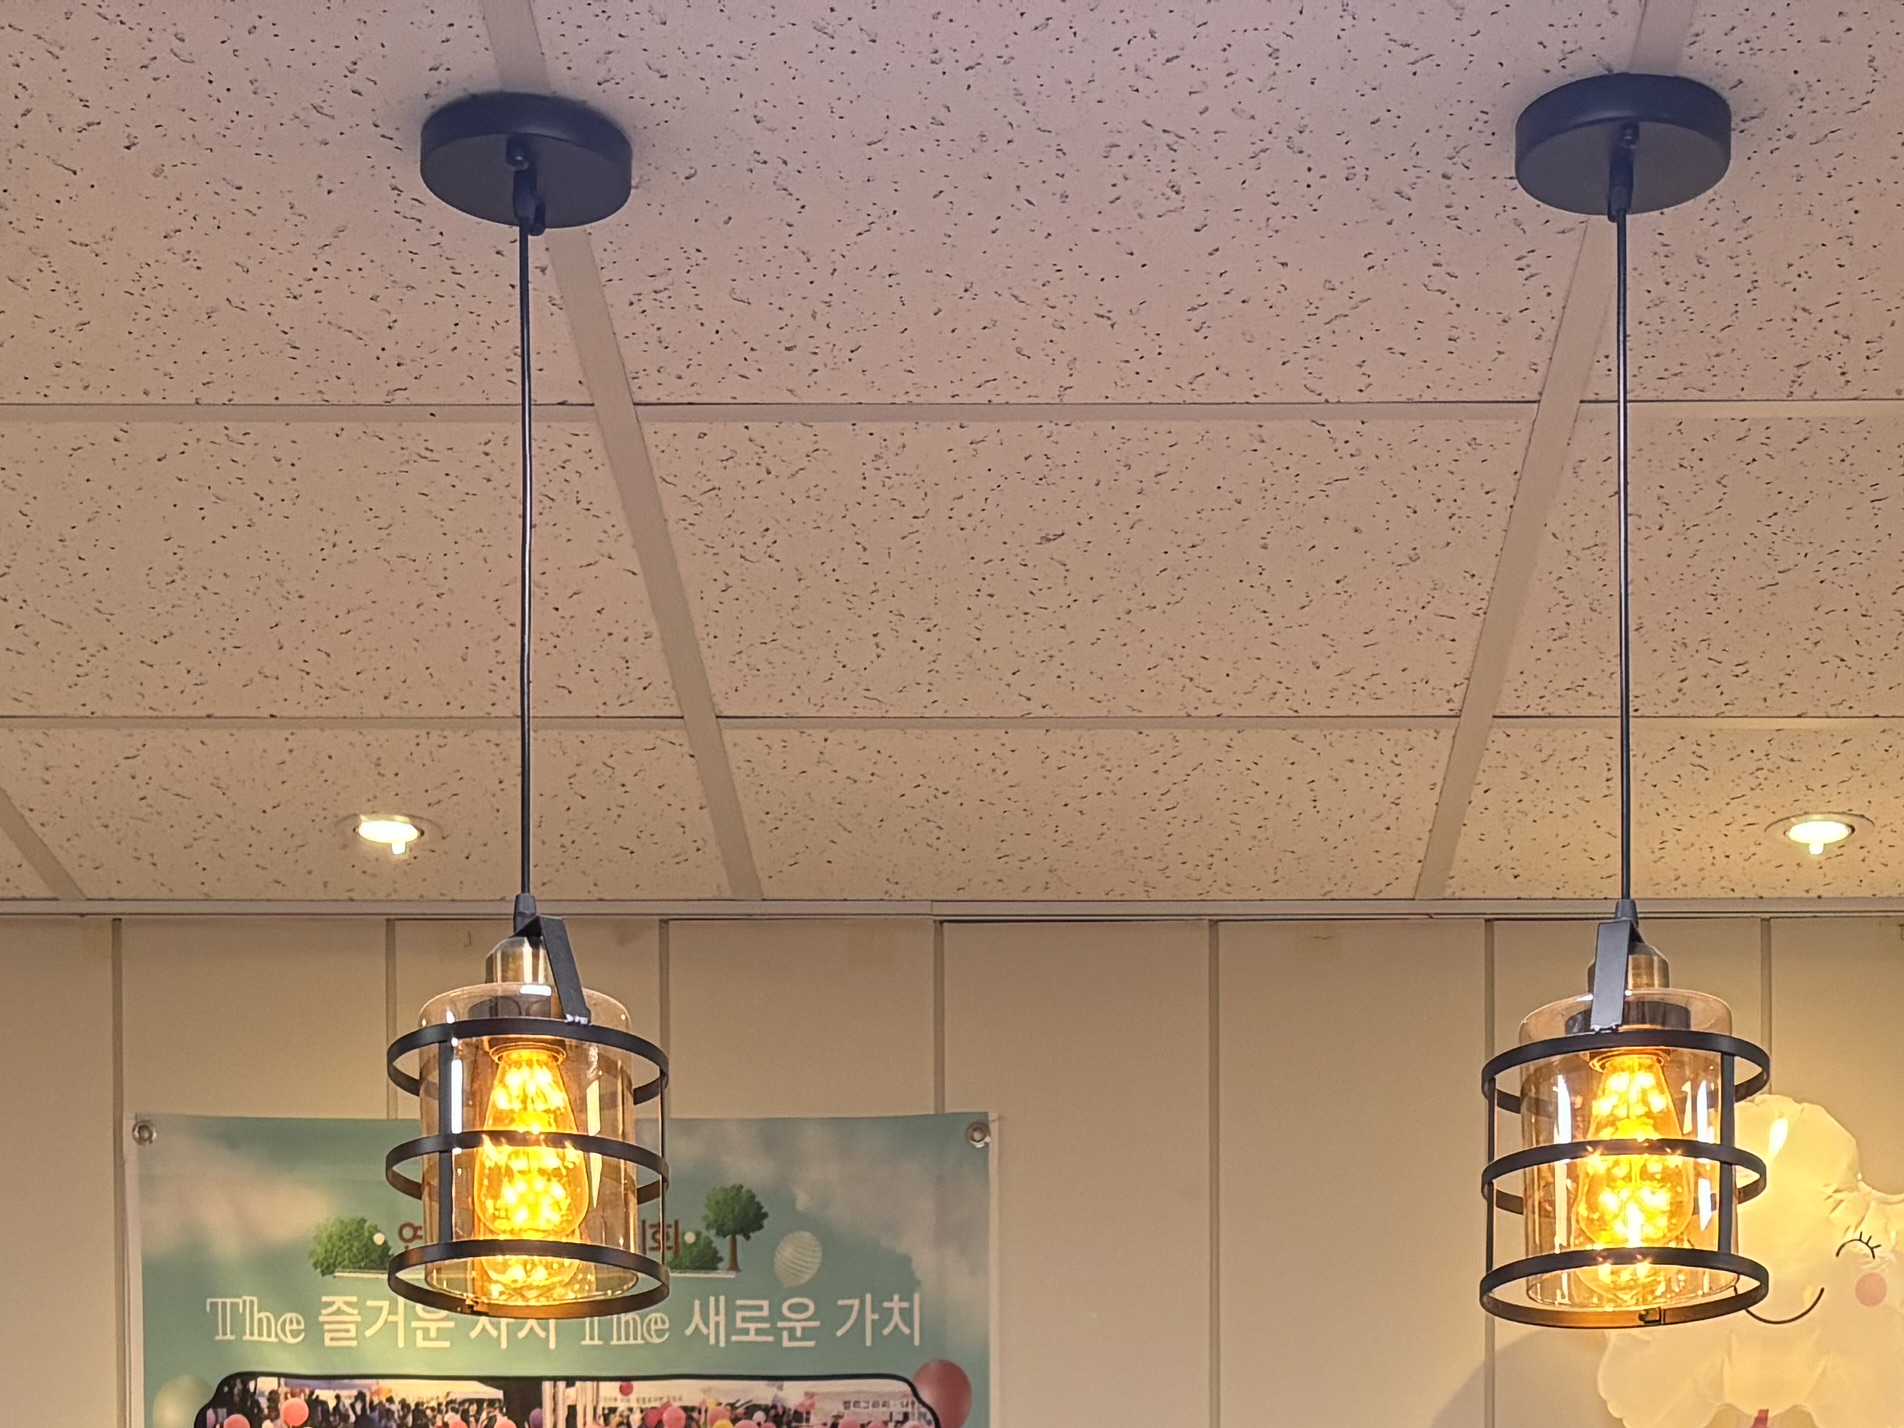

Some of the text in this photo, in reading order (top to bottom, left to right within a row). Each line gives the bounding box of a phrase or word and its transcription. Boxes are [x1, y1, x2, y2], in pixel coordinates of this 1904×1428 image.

[207, 1296, 304, 1343] The
[318, 1296, 455, 1348] 즐거운
[684, 1295, 821, 1347] 새로운
[836, 1292, 921, 1347] 가치
